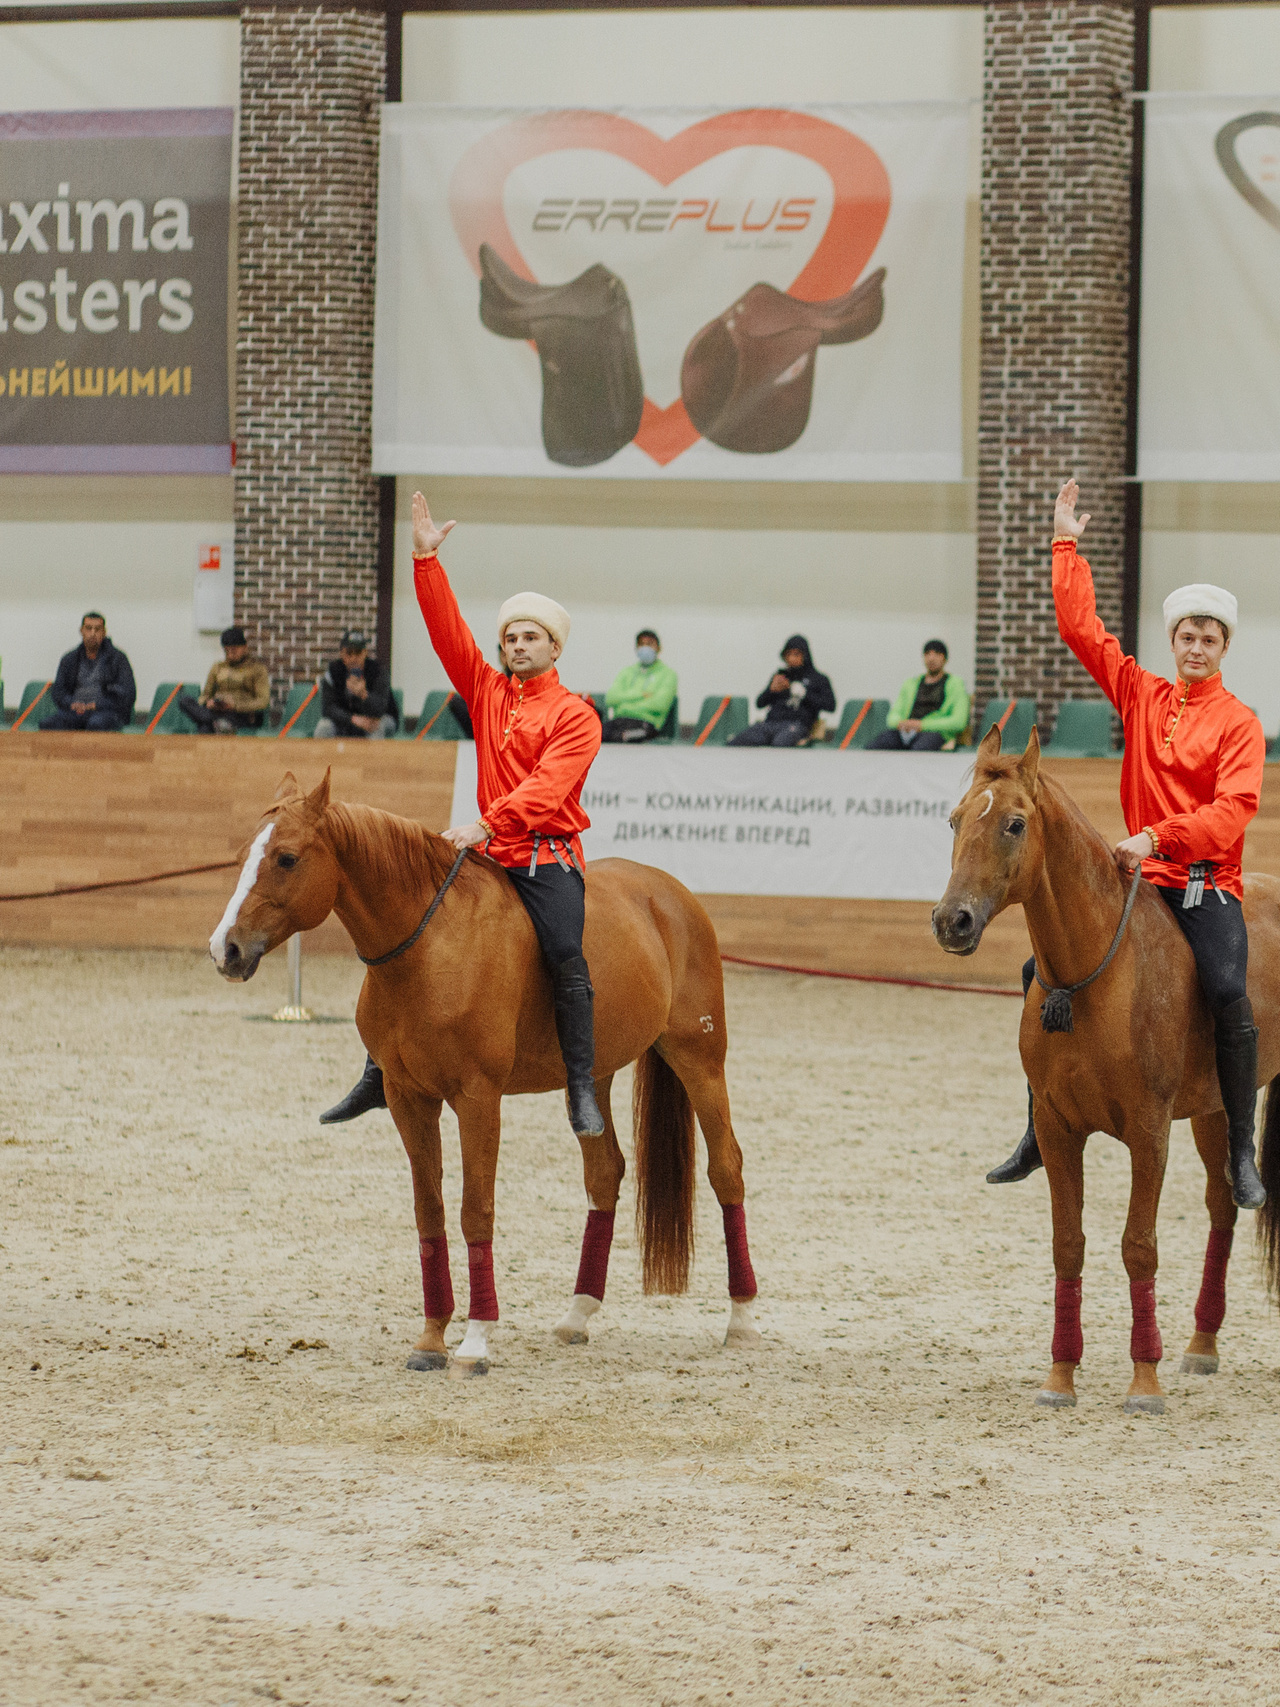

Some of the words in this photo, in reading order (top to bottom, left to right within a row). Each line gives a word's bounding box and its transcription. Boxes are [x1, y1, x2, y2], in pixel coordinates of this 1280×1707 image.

[0, 181, 194, 253] xima
[531, 198, 817, 232] ERREPLUS
[0, 267, 194, 334] sters
[645, 791, 837, 818] КОММУНИКАЦИИ,
[846, 798, 951, 819] РАЗВИТИЕ
[613, 820, 728, 843] ДВИЖЕНИЕ
[735, 824, 811, 847] ВПЕРЕД
